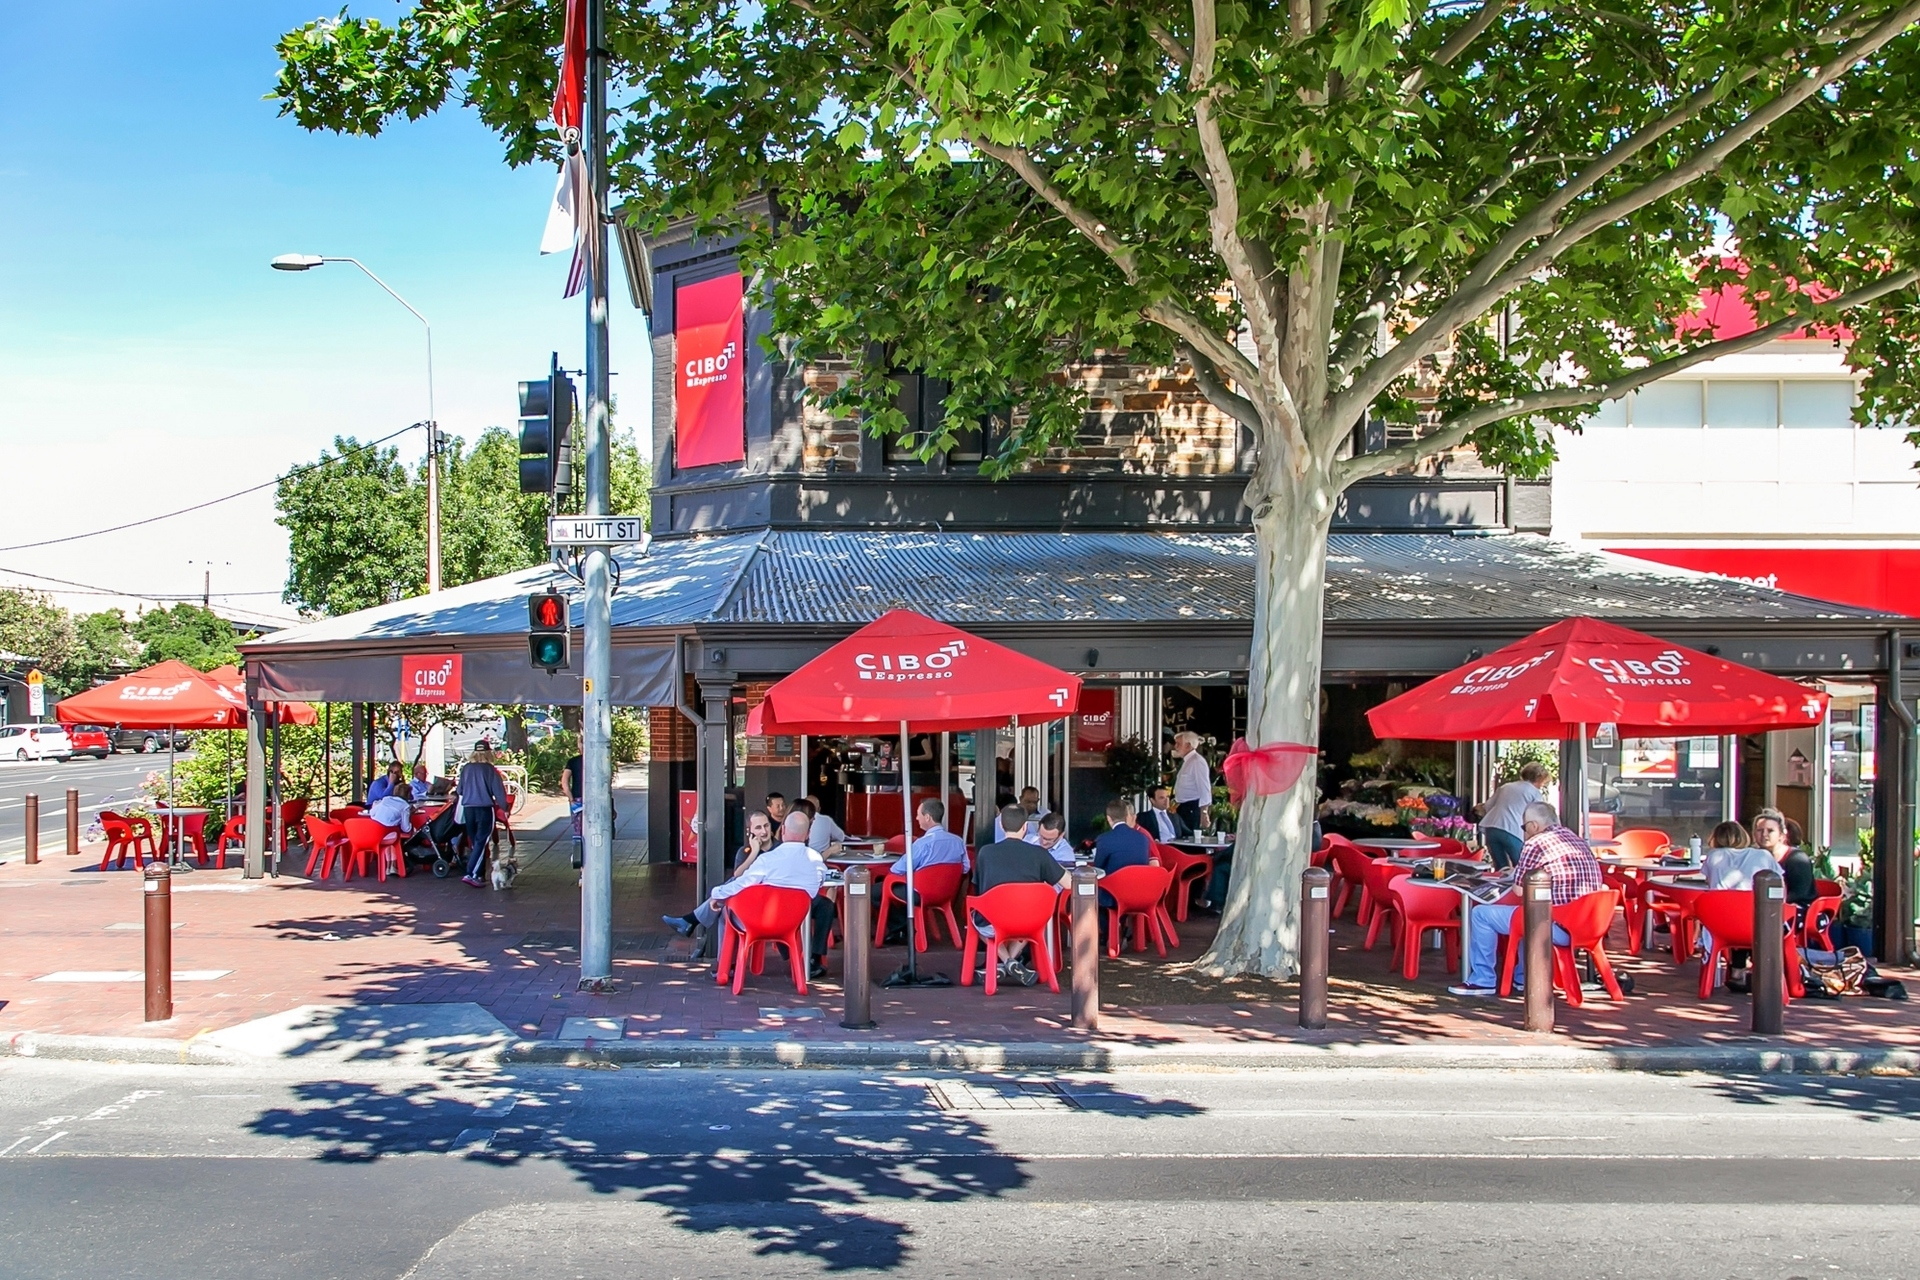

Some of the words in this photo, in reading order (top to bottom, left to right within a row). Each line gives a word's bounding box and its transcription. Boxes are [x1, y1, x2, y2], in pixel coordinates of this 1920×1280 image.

[685, 354, 729, 377] CIBO
[693, 373, 728, 387] Espresso
[574, 522, 613, 539] HUTT
[617, 522, 636, 539] ST
[854, 652, 952, 670] CIBO
[1588, 658, 1681, 675] CIBO
[414, 669, 447, 687] CIBO
[874, 671, 953, 682] Espresso
[1463, 662, 1531, 684] CIBO
[1459, 681, 1510, 696] Espresso
[1618, 675, 1692, 687] Espresso
[122, 685, 178, 696] CIBO
[420, 688, 446, 697] Espresso
[1083, 714, 1107, 722] CIBO
